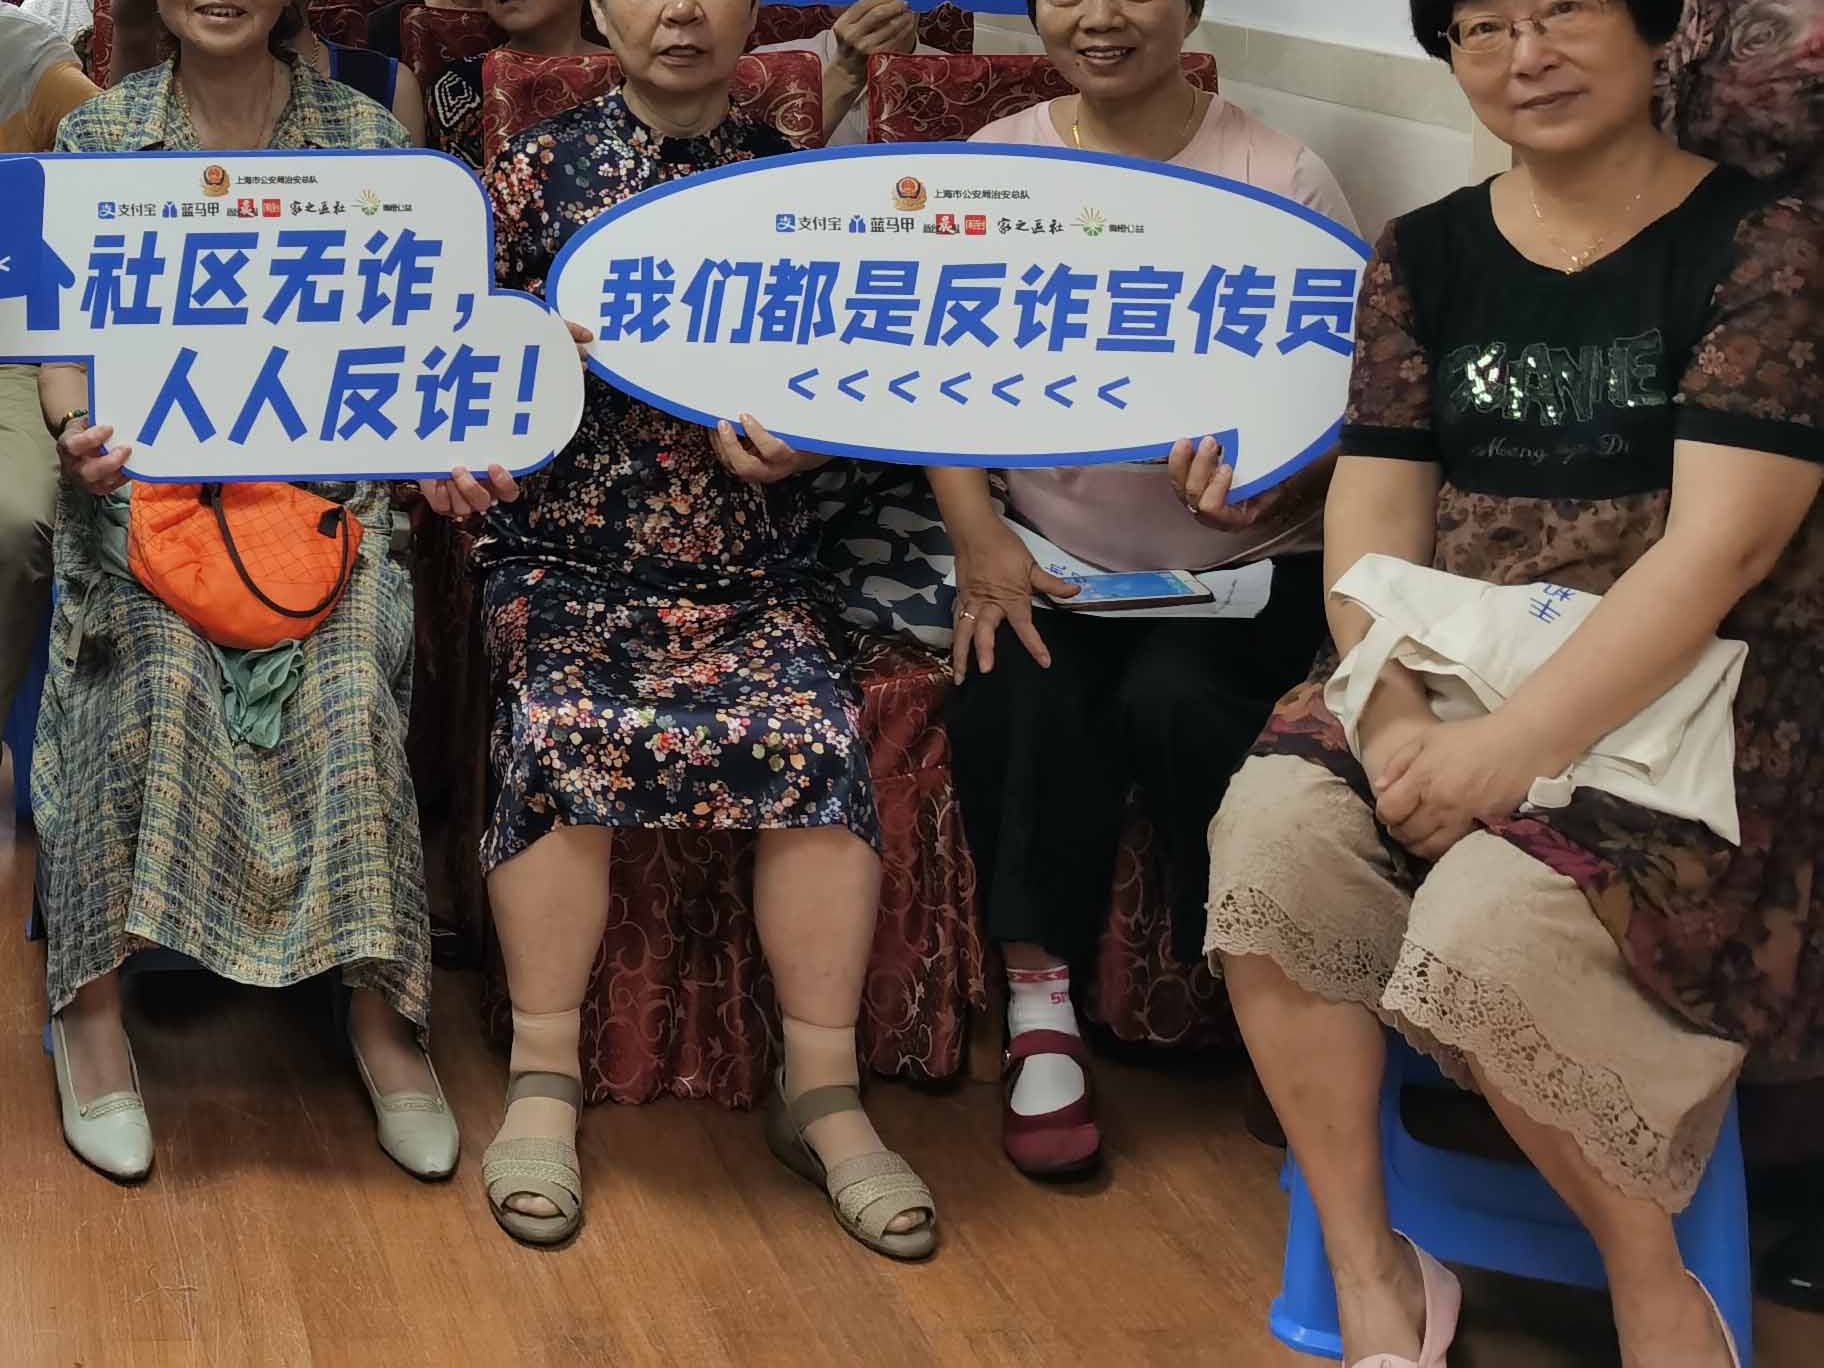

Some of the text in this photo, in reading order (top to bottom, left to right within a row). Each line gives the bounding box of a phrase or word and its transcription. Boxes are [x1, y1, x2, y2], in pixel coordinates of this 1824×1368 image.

[933, 188, 1031, 200] 上海市公安局治安总队
[117, 202, 157, 217] 支付宝
[181, 202, 220, 217] 蓝马甲
[798, 216, 842, 232] 支付宝
[869, 216, 915, 234] 蓝马甲
[599, 256, 1357, 357] 我们都是反诈宣传员
